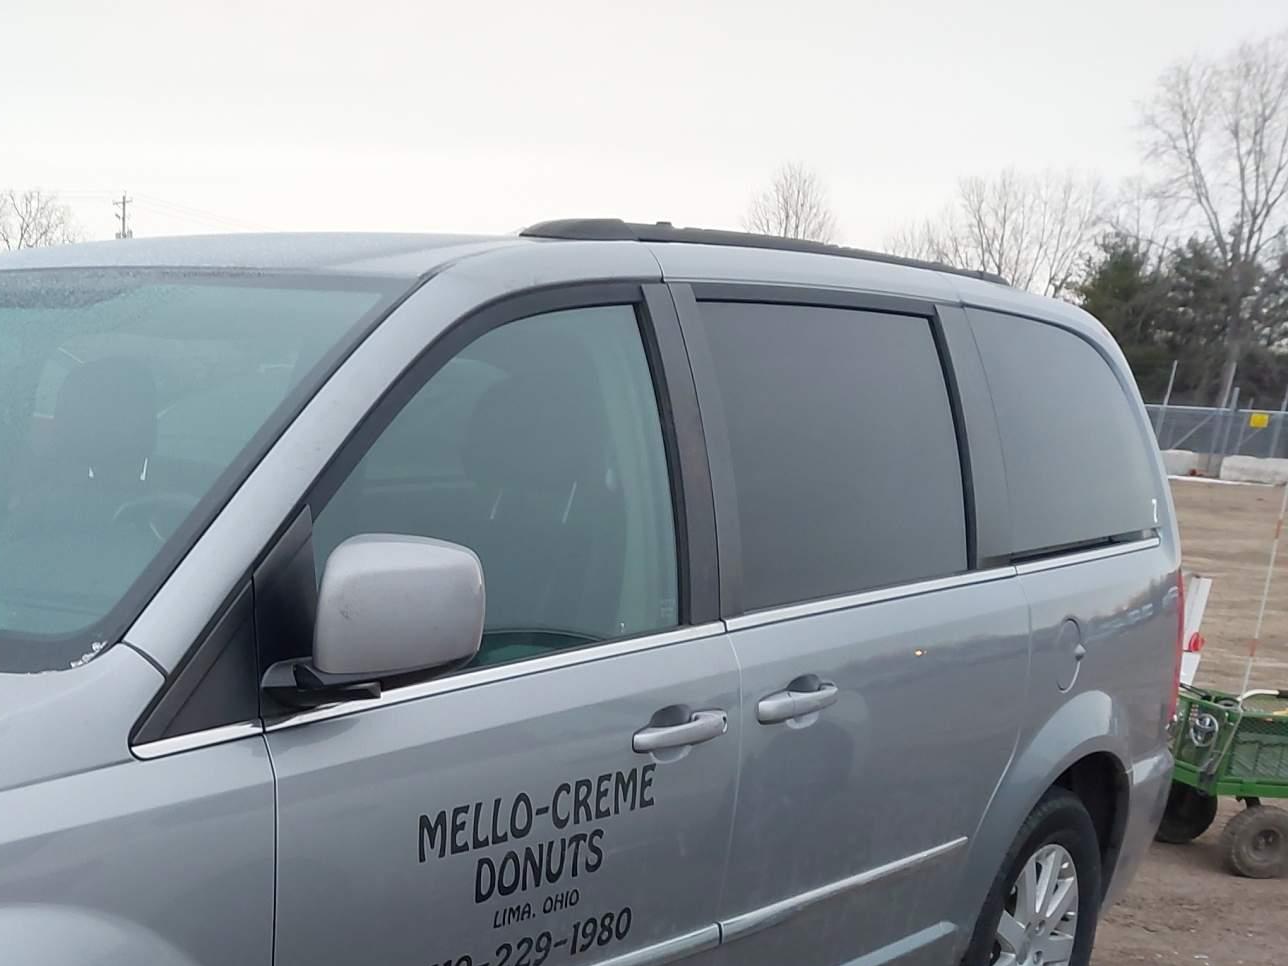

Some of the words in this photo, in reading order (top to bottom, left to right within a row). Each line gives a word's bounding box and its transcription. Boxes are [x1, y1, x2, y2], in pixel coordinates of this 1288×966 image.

[418, 763, 657, 863] MELLO-CREME
[475, 829, 604, 903] DONUTS
[543, 889, 580, 914] OHIO
